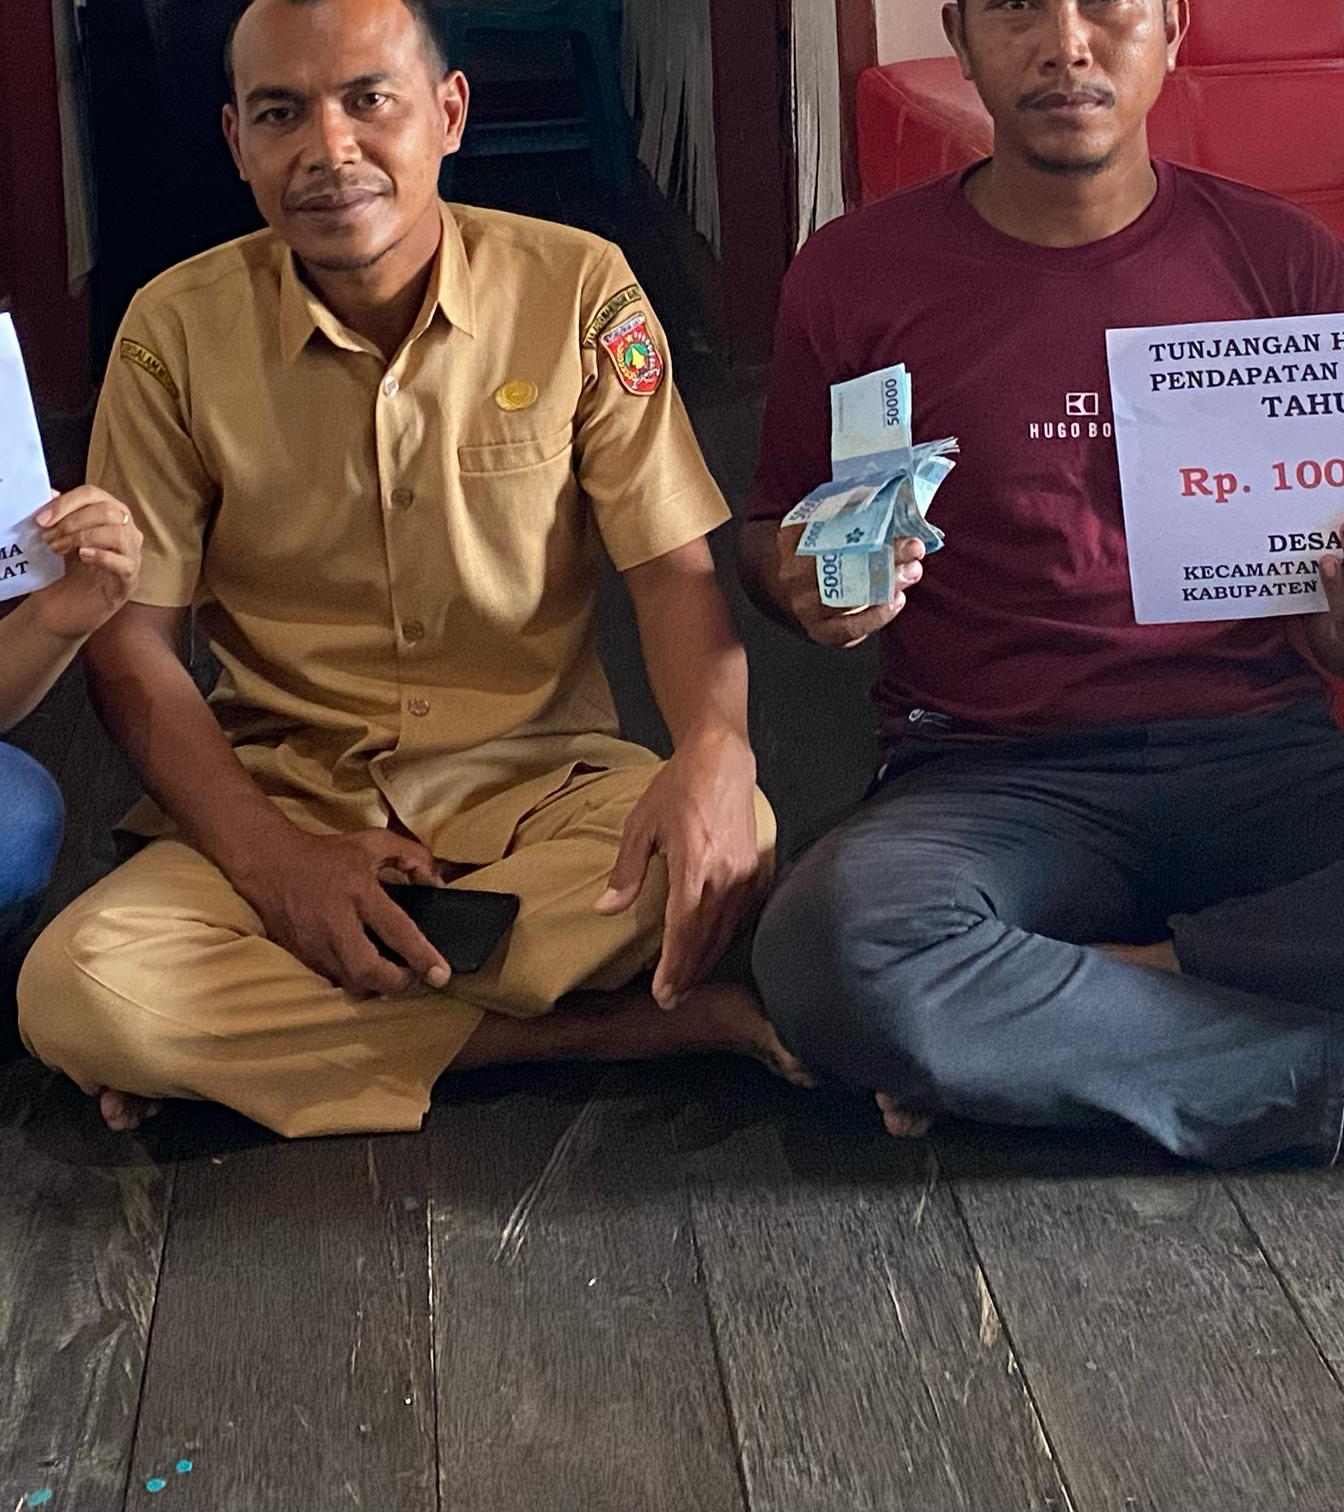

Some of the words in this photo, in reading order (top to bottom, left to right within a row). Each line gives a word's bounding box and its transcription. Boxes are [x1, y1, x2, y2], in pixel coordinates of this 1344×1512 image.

[1148, 333, 1320, 362] TUNJANGAN
[1149, 361, 1338, 392] PENDAPATAN
[885, 378, 899, 426] 50000
[1030, 423, 1080, 438] HUGO
[1089, 423, 1112, 438] BO
[1178, 467, 1251, 503] Rp.
[1268, 531, 1342, 553] DESA
[822, 553, 839, 599] 5000
[1181, 576, 1323, 601] KABUPATEN
